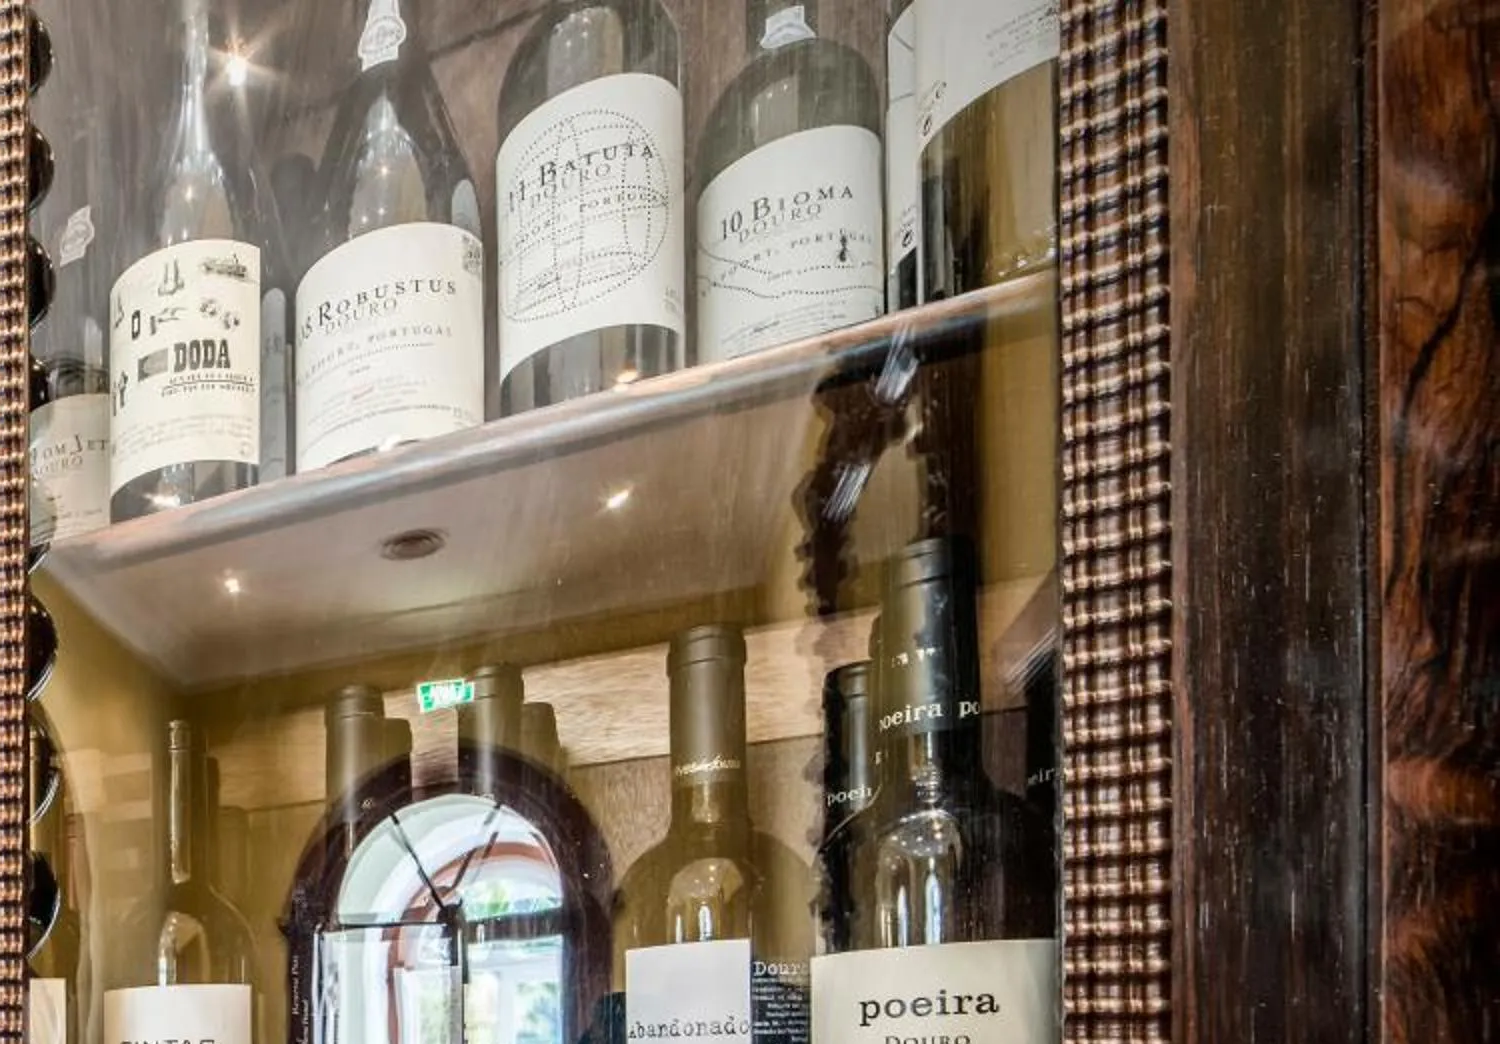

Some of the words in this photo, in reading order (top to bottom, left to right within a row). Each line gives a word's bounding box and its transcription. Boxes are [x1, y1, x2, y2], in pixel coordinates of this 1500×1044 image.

[540, 143, 655, 187] BATUTA
[721, 210, 743, 240] 10
[753, 185, 853, 221] BIOMA
[739, 203, 821, 243] DOURO
[318, 279, 457, 327] ROBUSTUS
[325, 298, 398, 336] DOURO
[173, 339, 231, 373] DODA
[628, 1015, 750, 1039] Abandonado
[859, 989, 1000, 1027] poeira
